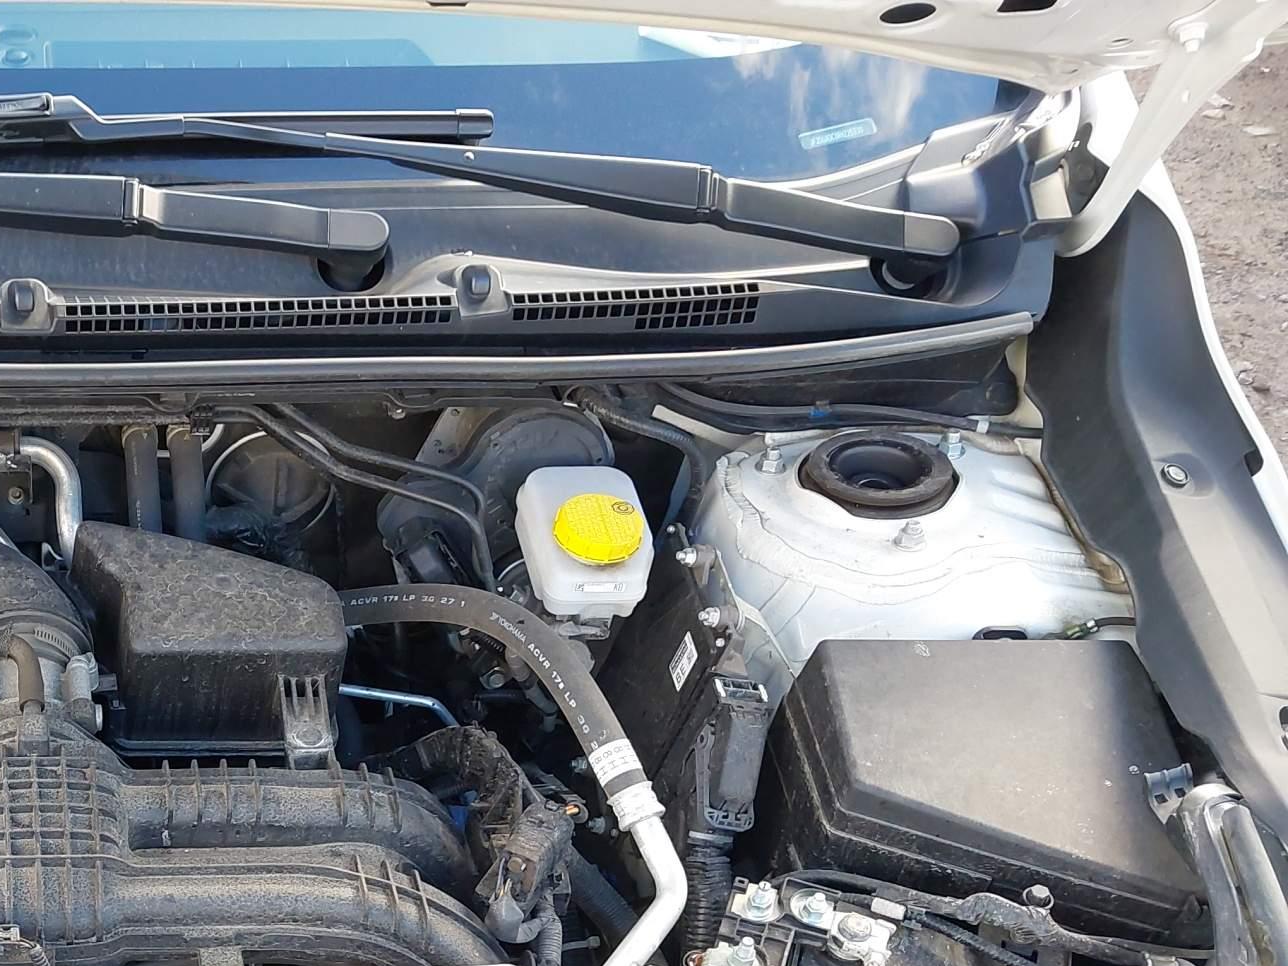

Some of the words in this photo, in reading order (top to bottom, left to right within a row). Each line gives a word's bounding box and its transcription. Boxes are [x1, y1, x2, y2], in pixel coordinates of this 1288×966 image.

[350, 596, 379, 606] ACVR
[440, 597, 455, 605] 27
[497, 615, 528, 643] YOKOHAMA
[527, 643, 551, 669] ACVR
[564, 691, 578, 709] LP
